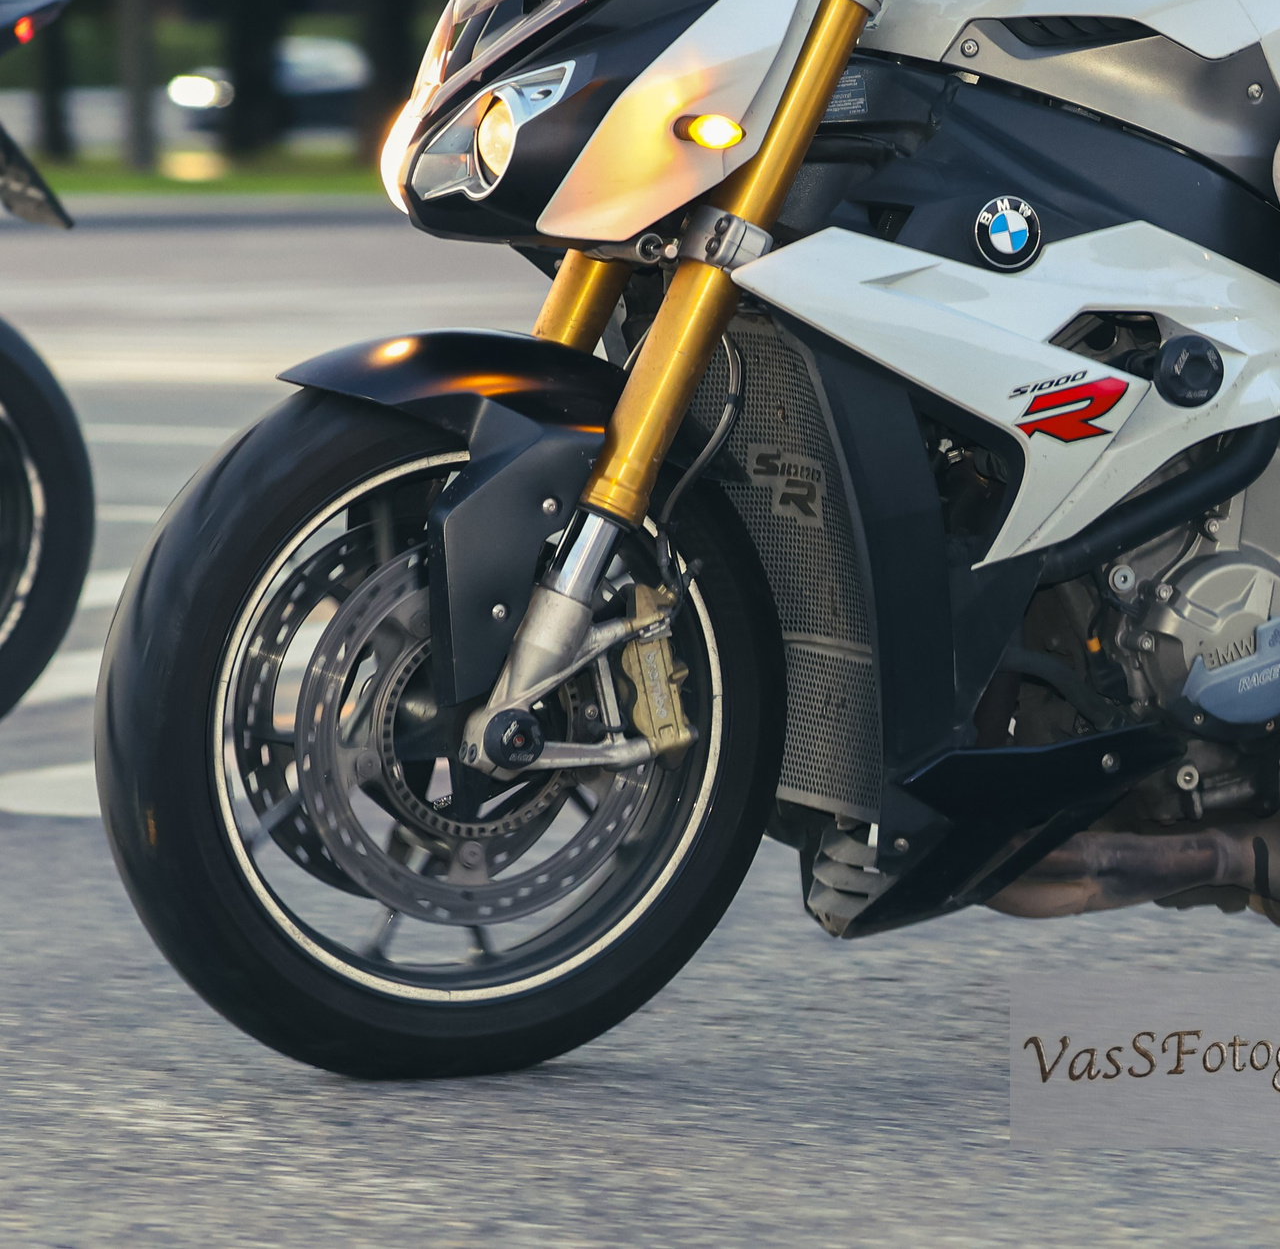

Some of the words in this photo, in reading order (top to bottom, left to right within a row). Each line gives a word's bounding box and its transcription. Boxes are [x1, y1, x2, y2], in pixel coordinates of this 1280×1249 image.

[980, 198, 1032, 226] BMW
[1010, 369, 1088, 398] S1000
[1014, 376, 1130, 443] R
[778, 478, 818, 519] R
[1205, 635, 1256, 669] BMW
[644, 650, 669, 720] brembo
[1237, 664, 1280, 693] RACE
